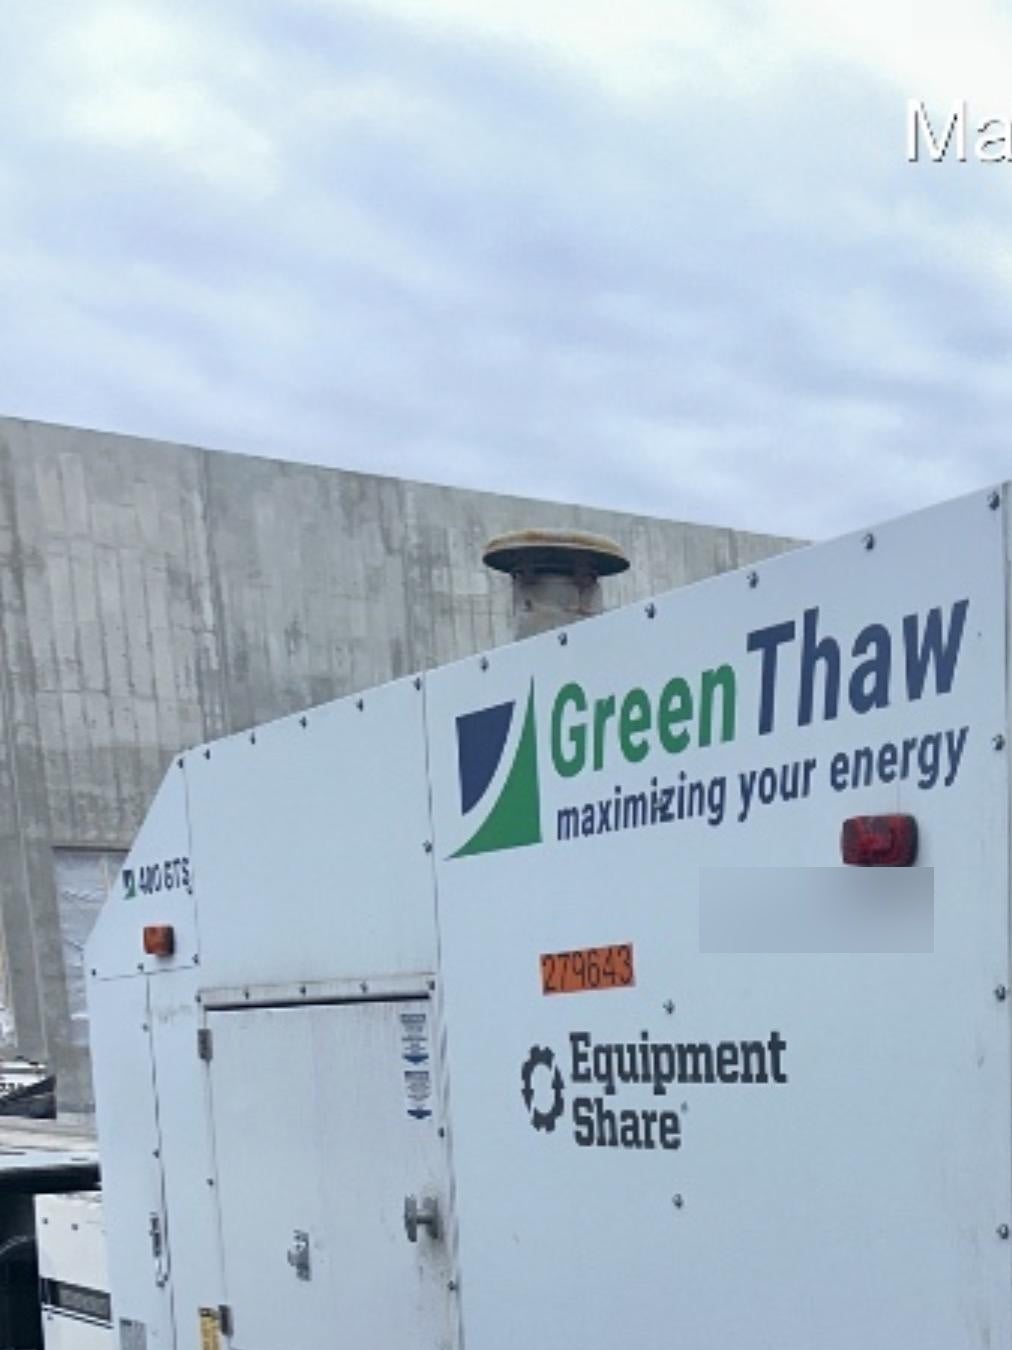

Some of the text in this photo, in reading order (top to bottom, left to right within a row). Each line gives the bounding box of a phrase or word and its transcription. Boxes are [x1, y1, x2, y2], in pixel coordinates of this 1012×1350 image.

[556, 725, 970, 842] maximizing your energy
[541, 944, 634, 993] 279643
[569, 1030, 788, 1095] Equipment
